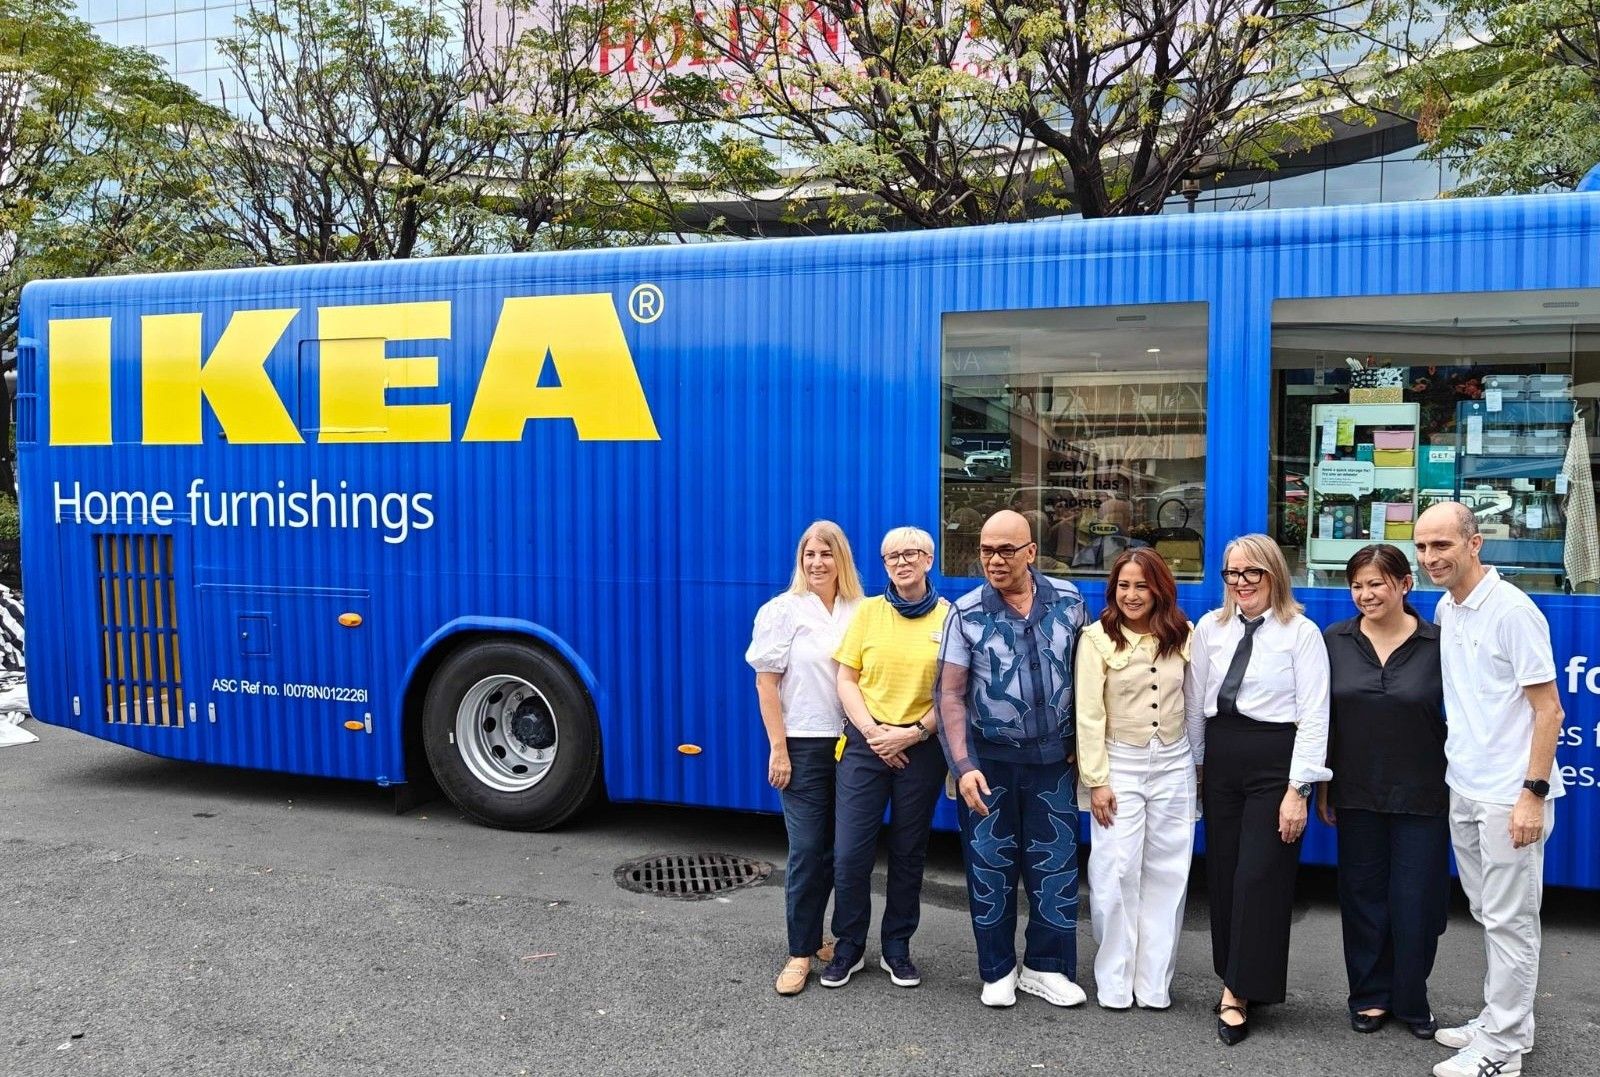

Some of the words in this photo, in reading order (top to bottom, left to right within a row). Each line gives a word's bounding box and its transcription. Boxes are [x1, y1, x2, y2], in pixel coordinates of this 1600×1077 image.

[49, 292, 661, 446] IKEA
[1046, 460, 1089, 473] every
[54, 481, 174, 525] Home
[186, 478, 434, 544] furnishings
[212, 678, 238, 693] ASC
[240, 680, 261, 694] Ref
[262, 684, 280, 696] no.
